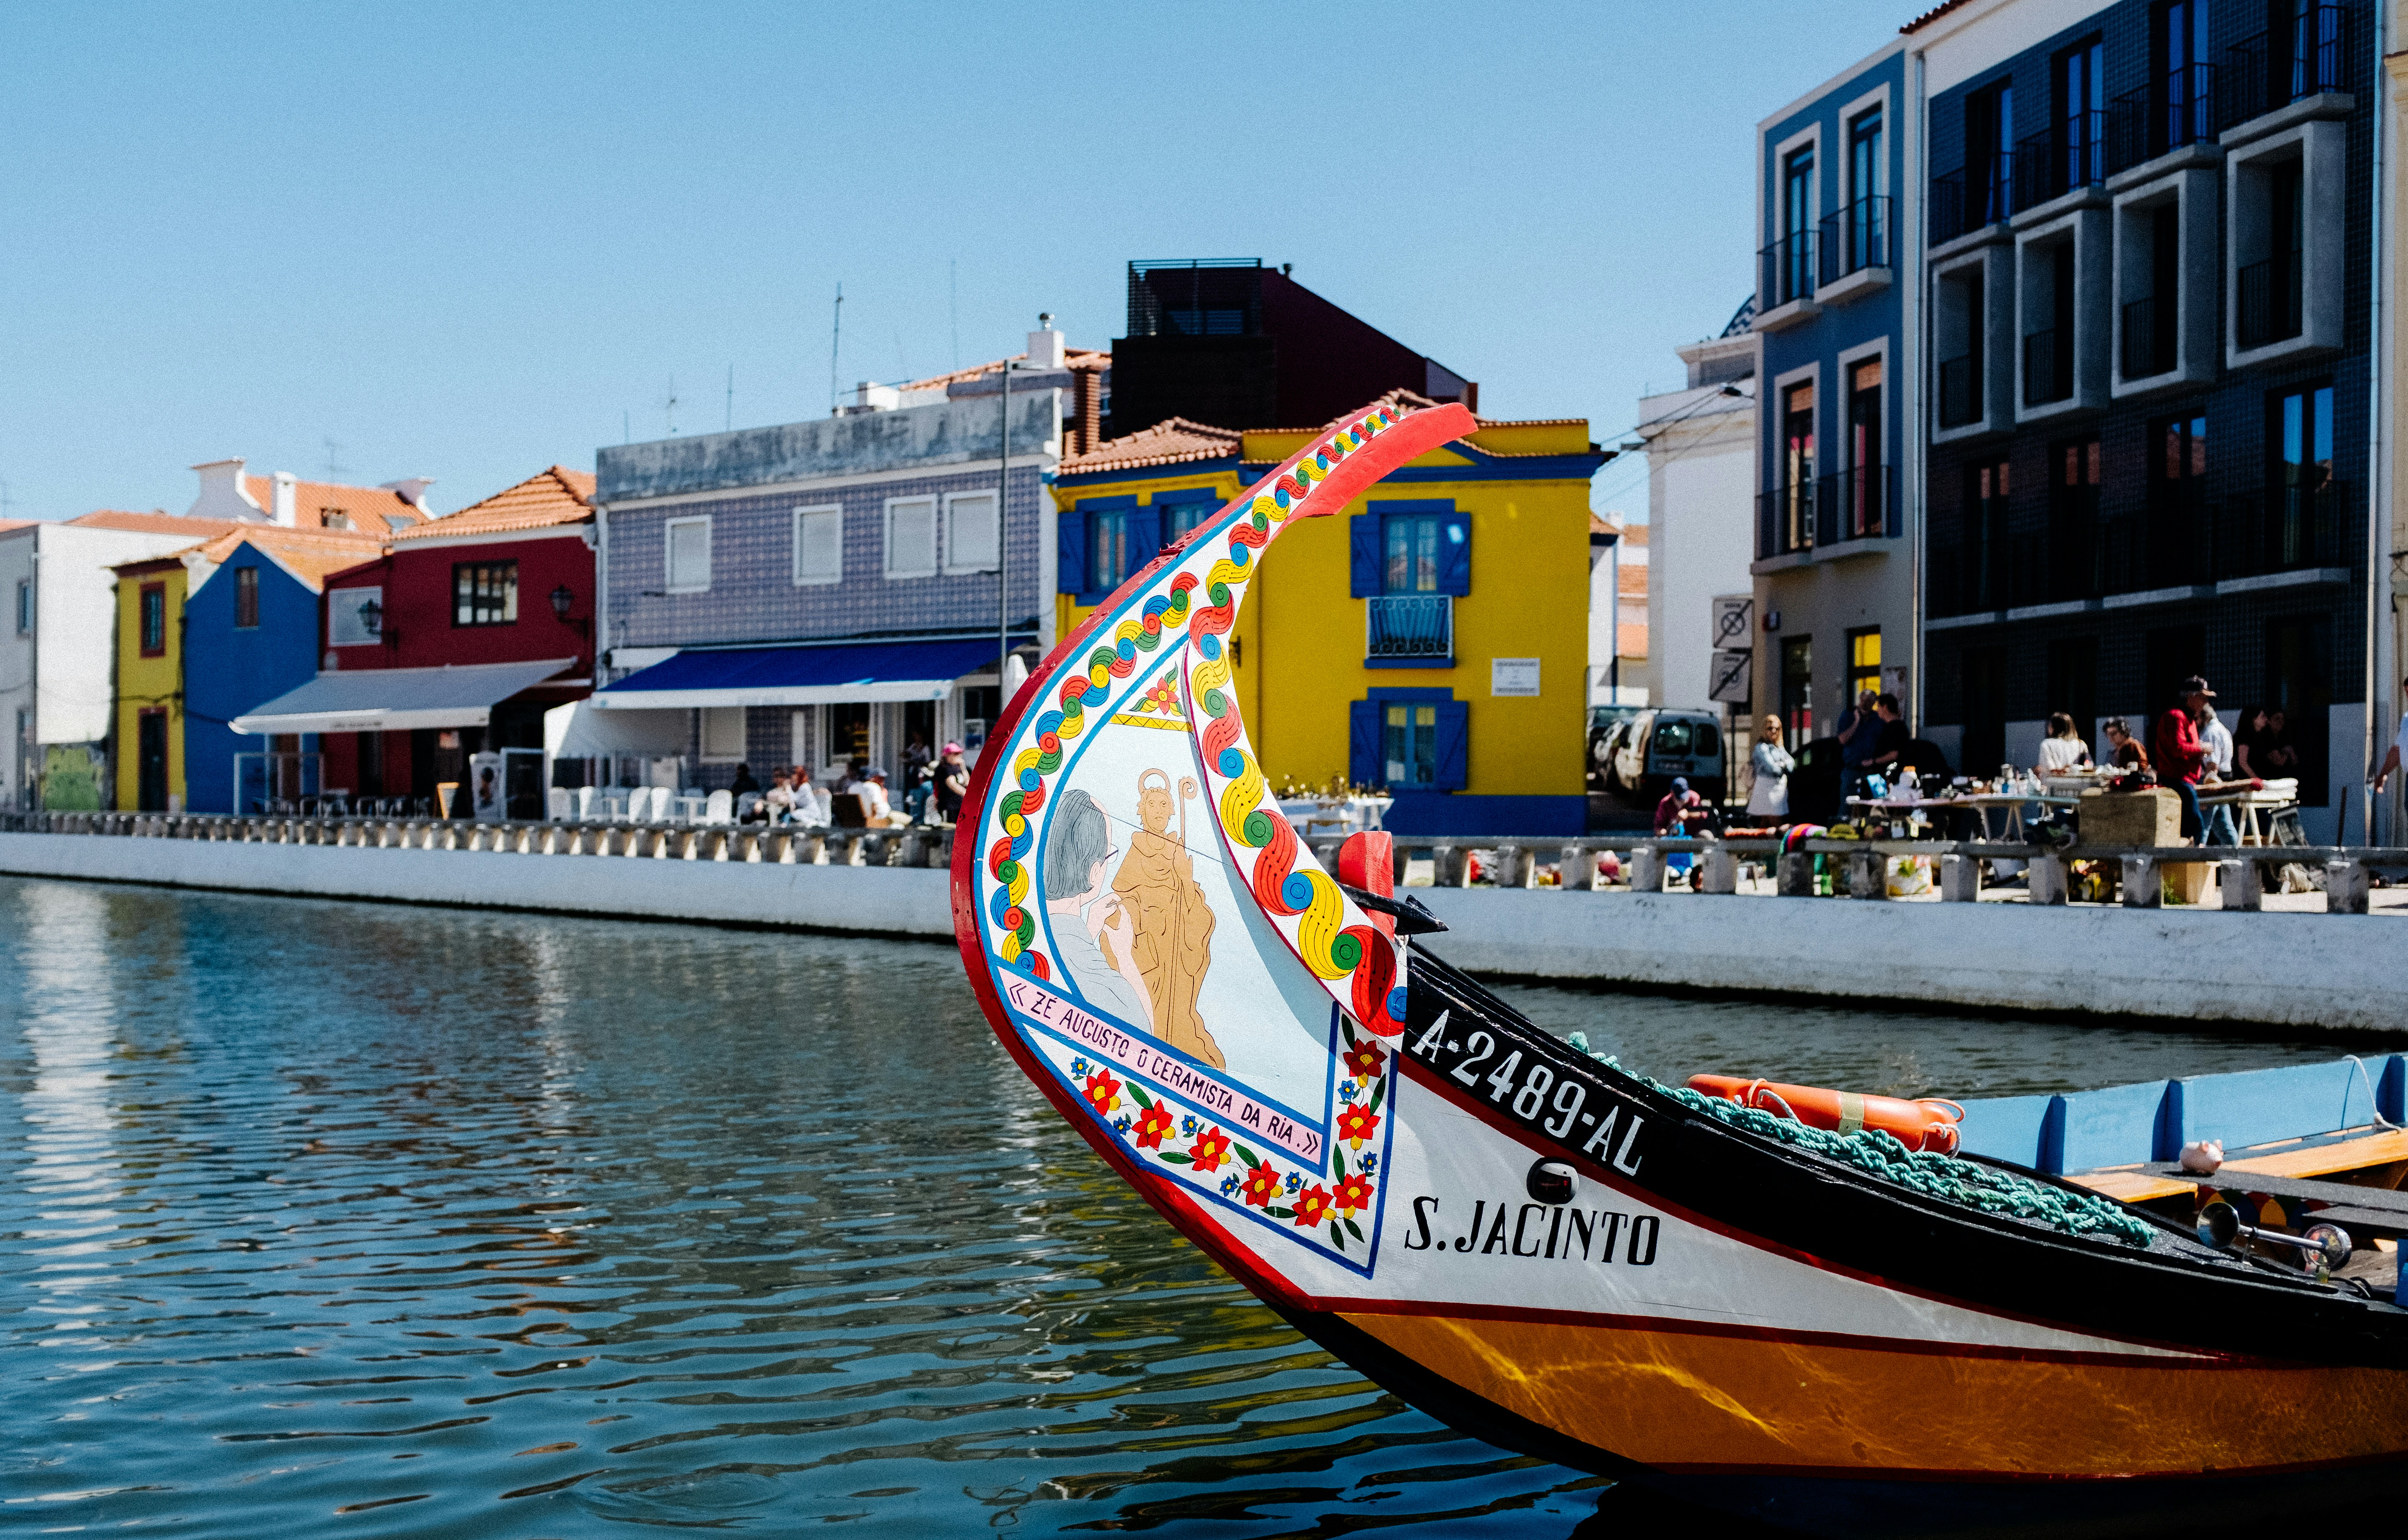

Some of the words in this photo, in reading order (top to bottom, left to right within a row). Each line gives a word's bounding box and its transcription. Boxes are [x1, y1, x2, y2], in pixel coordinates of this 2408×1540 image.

[1059, 1009, 1130, 1058] AUGUSTO
[1137, 1049, 1148, 1068] O
[1241, 1103, 1260, 1128] DA
[1411, 1009, 1644, 1176] A-2489-AL
